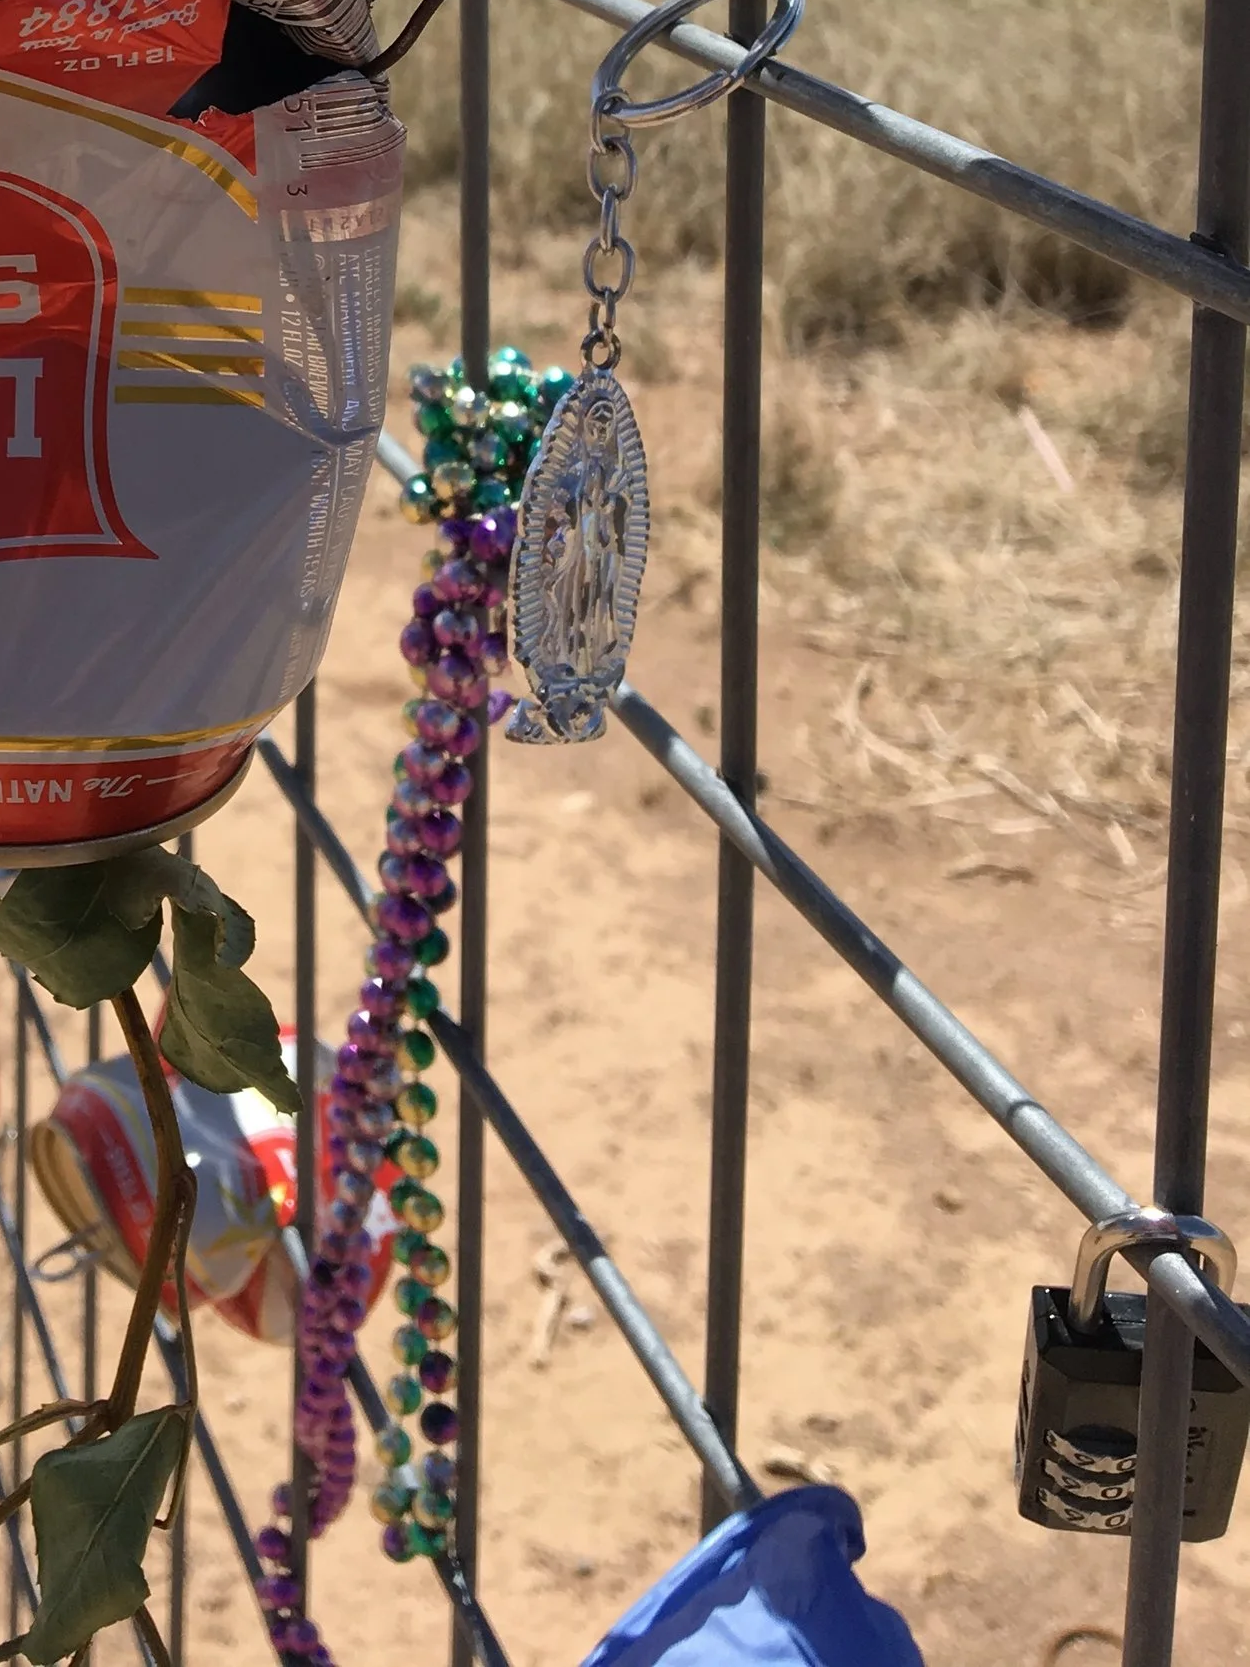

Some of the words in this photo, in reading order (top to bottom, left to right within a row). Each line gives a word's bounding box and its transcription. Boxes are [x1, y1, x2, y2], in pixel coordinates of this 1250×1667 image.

[107, 51, 139, 68] FL
[146, 45, 176, 64] 12
[81, 773, 142, 799] The
